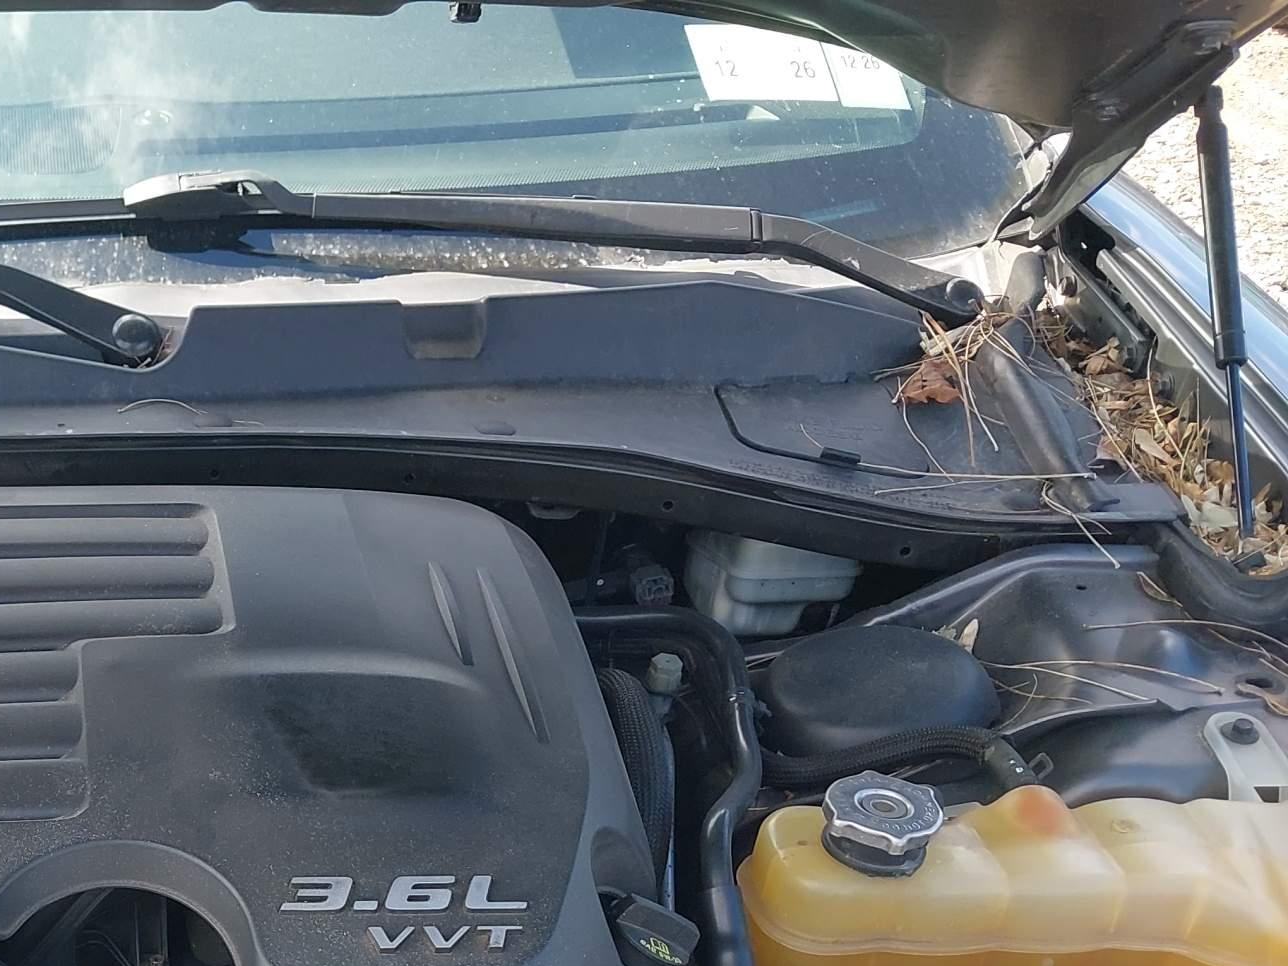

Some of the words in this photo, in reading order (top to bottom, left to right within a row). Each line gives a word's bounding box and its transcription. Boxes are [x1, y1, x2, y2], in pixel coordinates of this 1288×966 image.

[715, 60, 738, 77] 12
[790, 61, 816, 78] 26
[840, 55, 857, 69] 12
[279, 875, 528, 912] 3.6L
[367, 925, 523, 952] VVT
